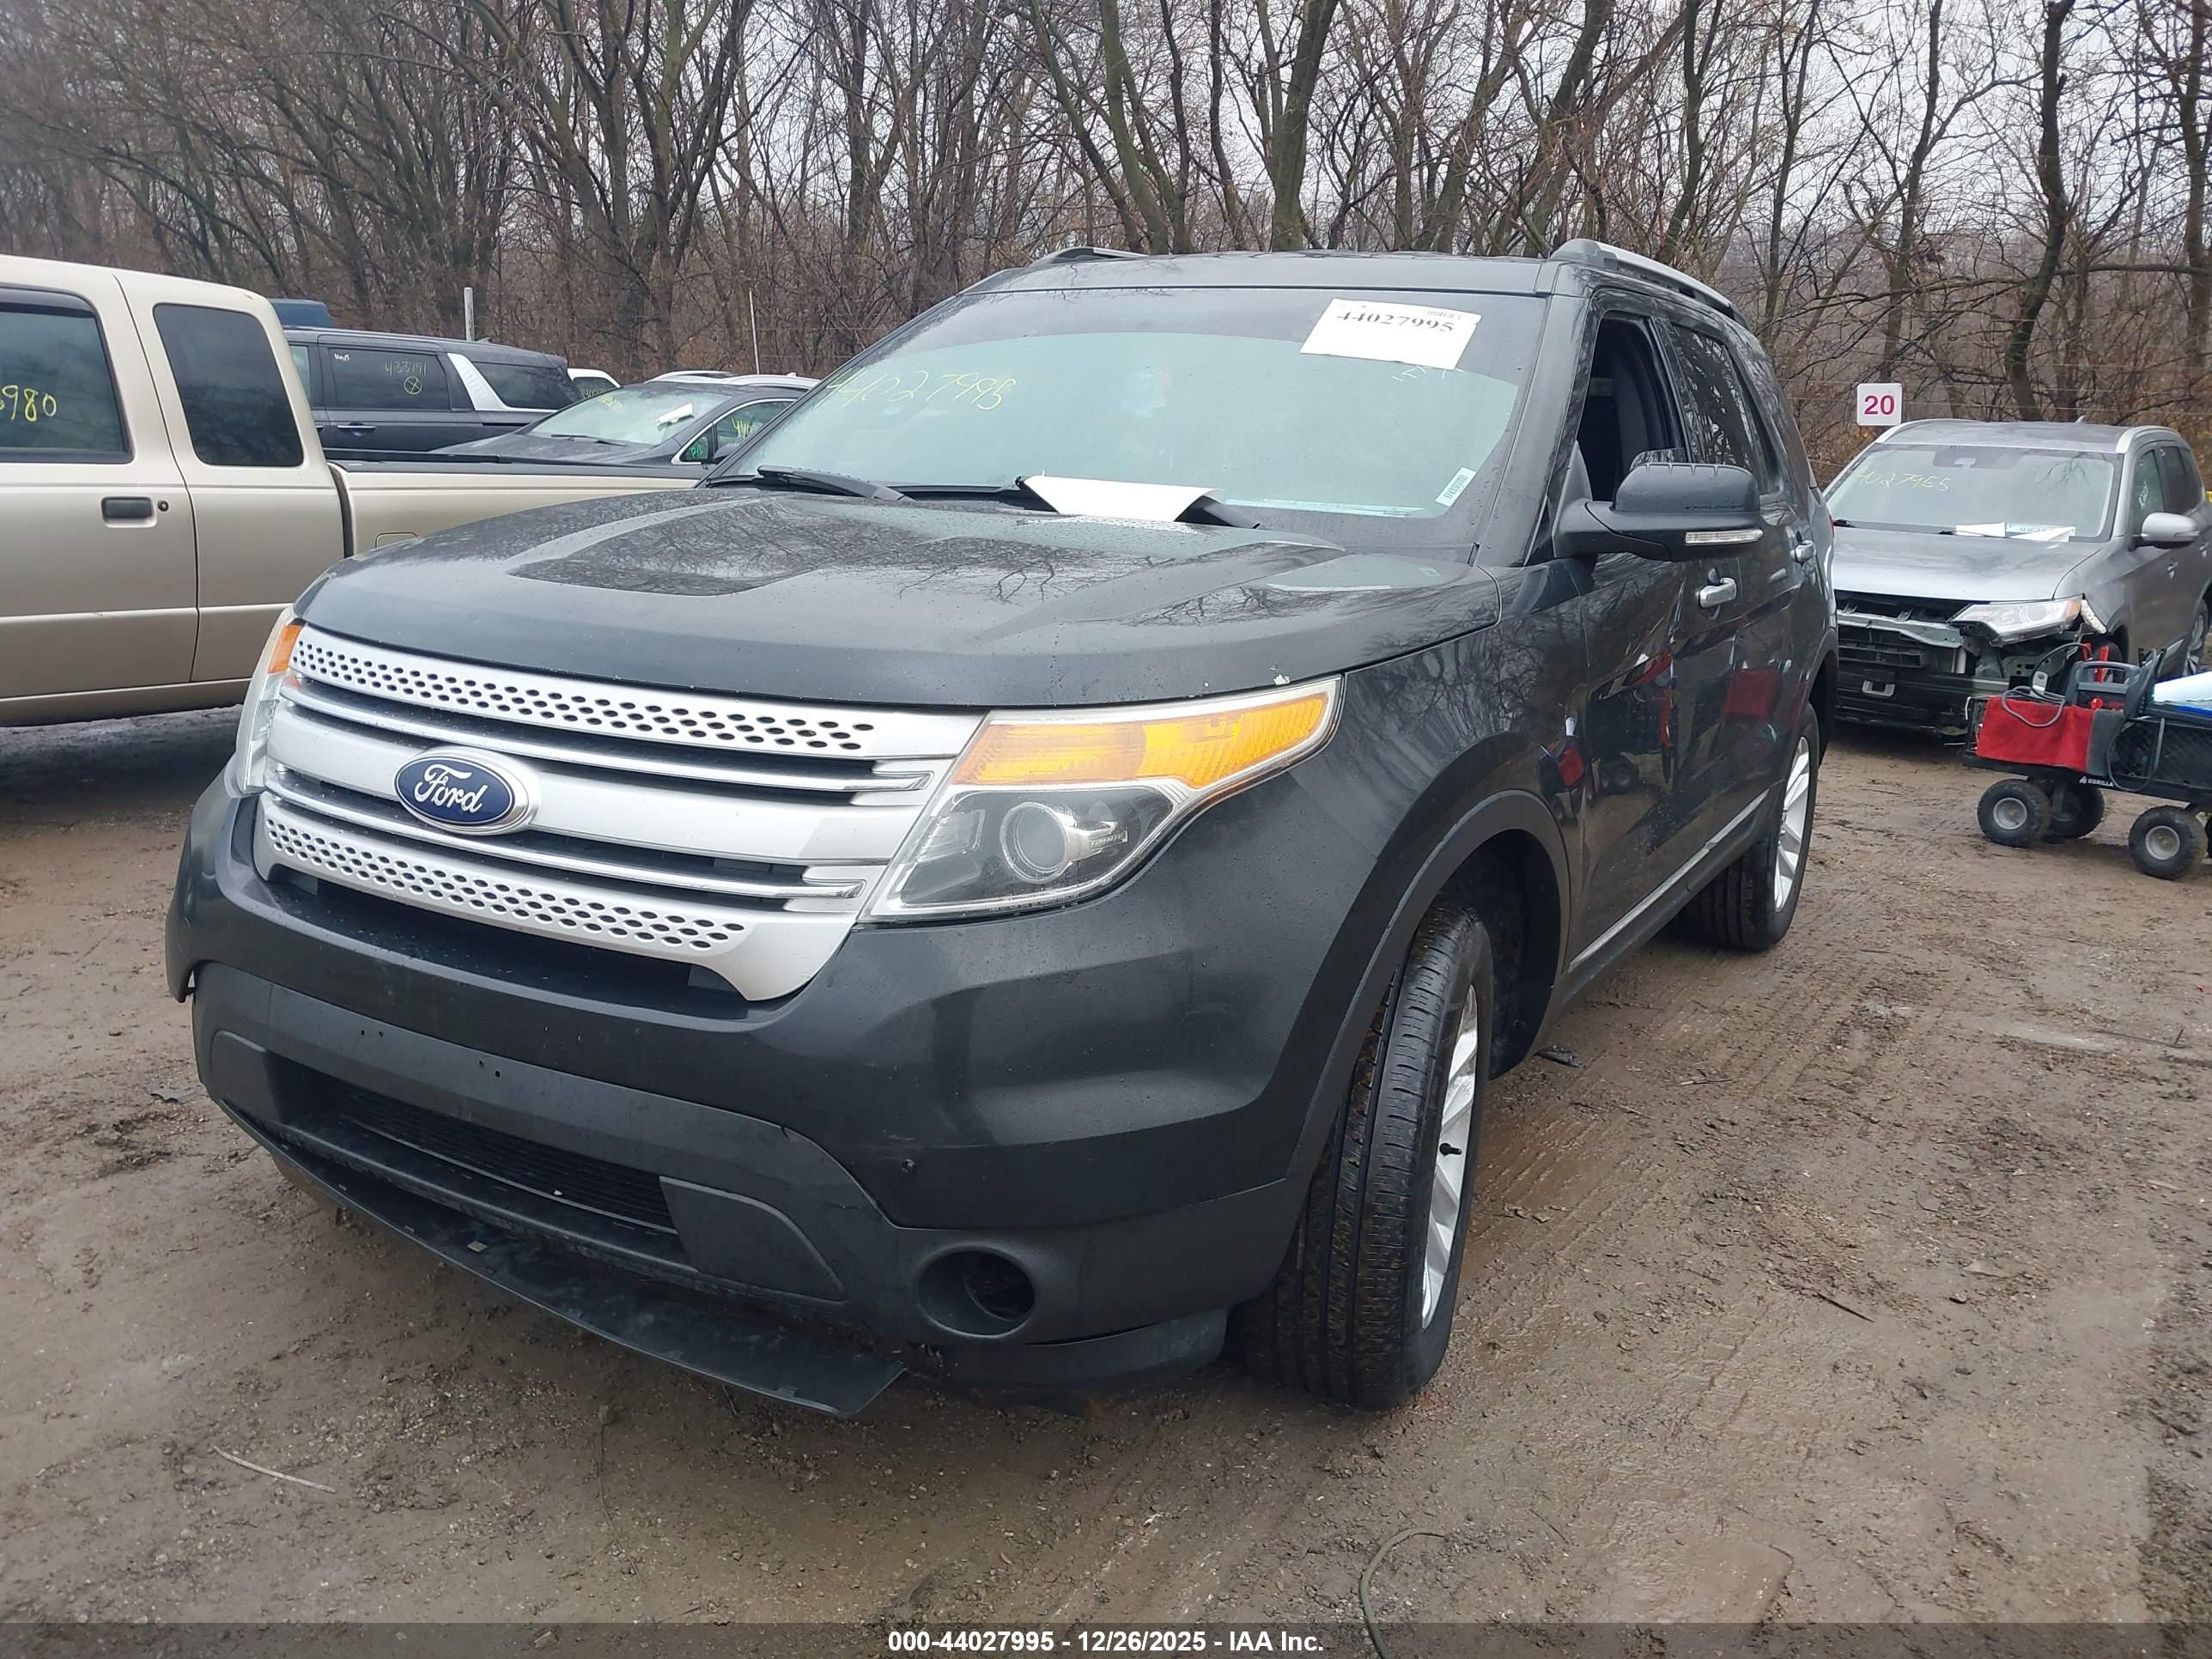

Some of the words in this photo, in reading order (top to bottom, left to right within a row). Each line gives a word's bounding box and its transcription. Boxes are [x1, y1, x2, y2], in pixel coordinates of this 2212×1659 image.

[1337, 311, 1455, 332] 44027995
[1863, 395, 1895, 415] 20
[414, 763, 489, 814] Ford
